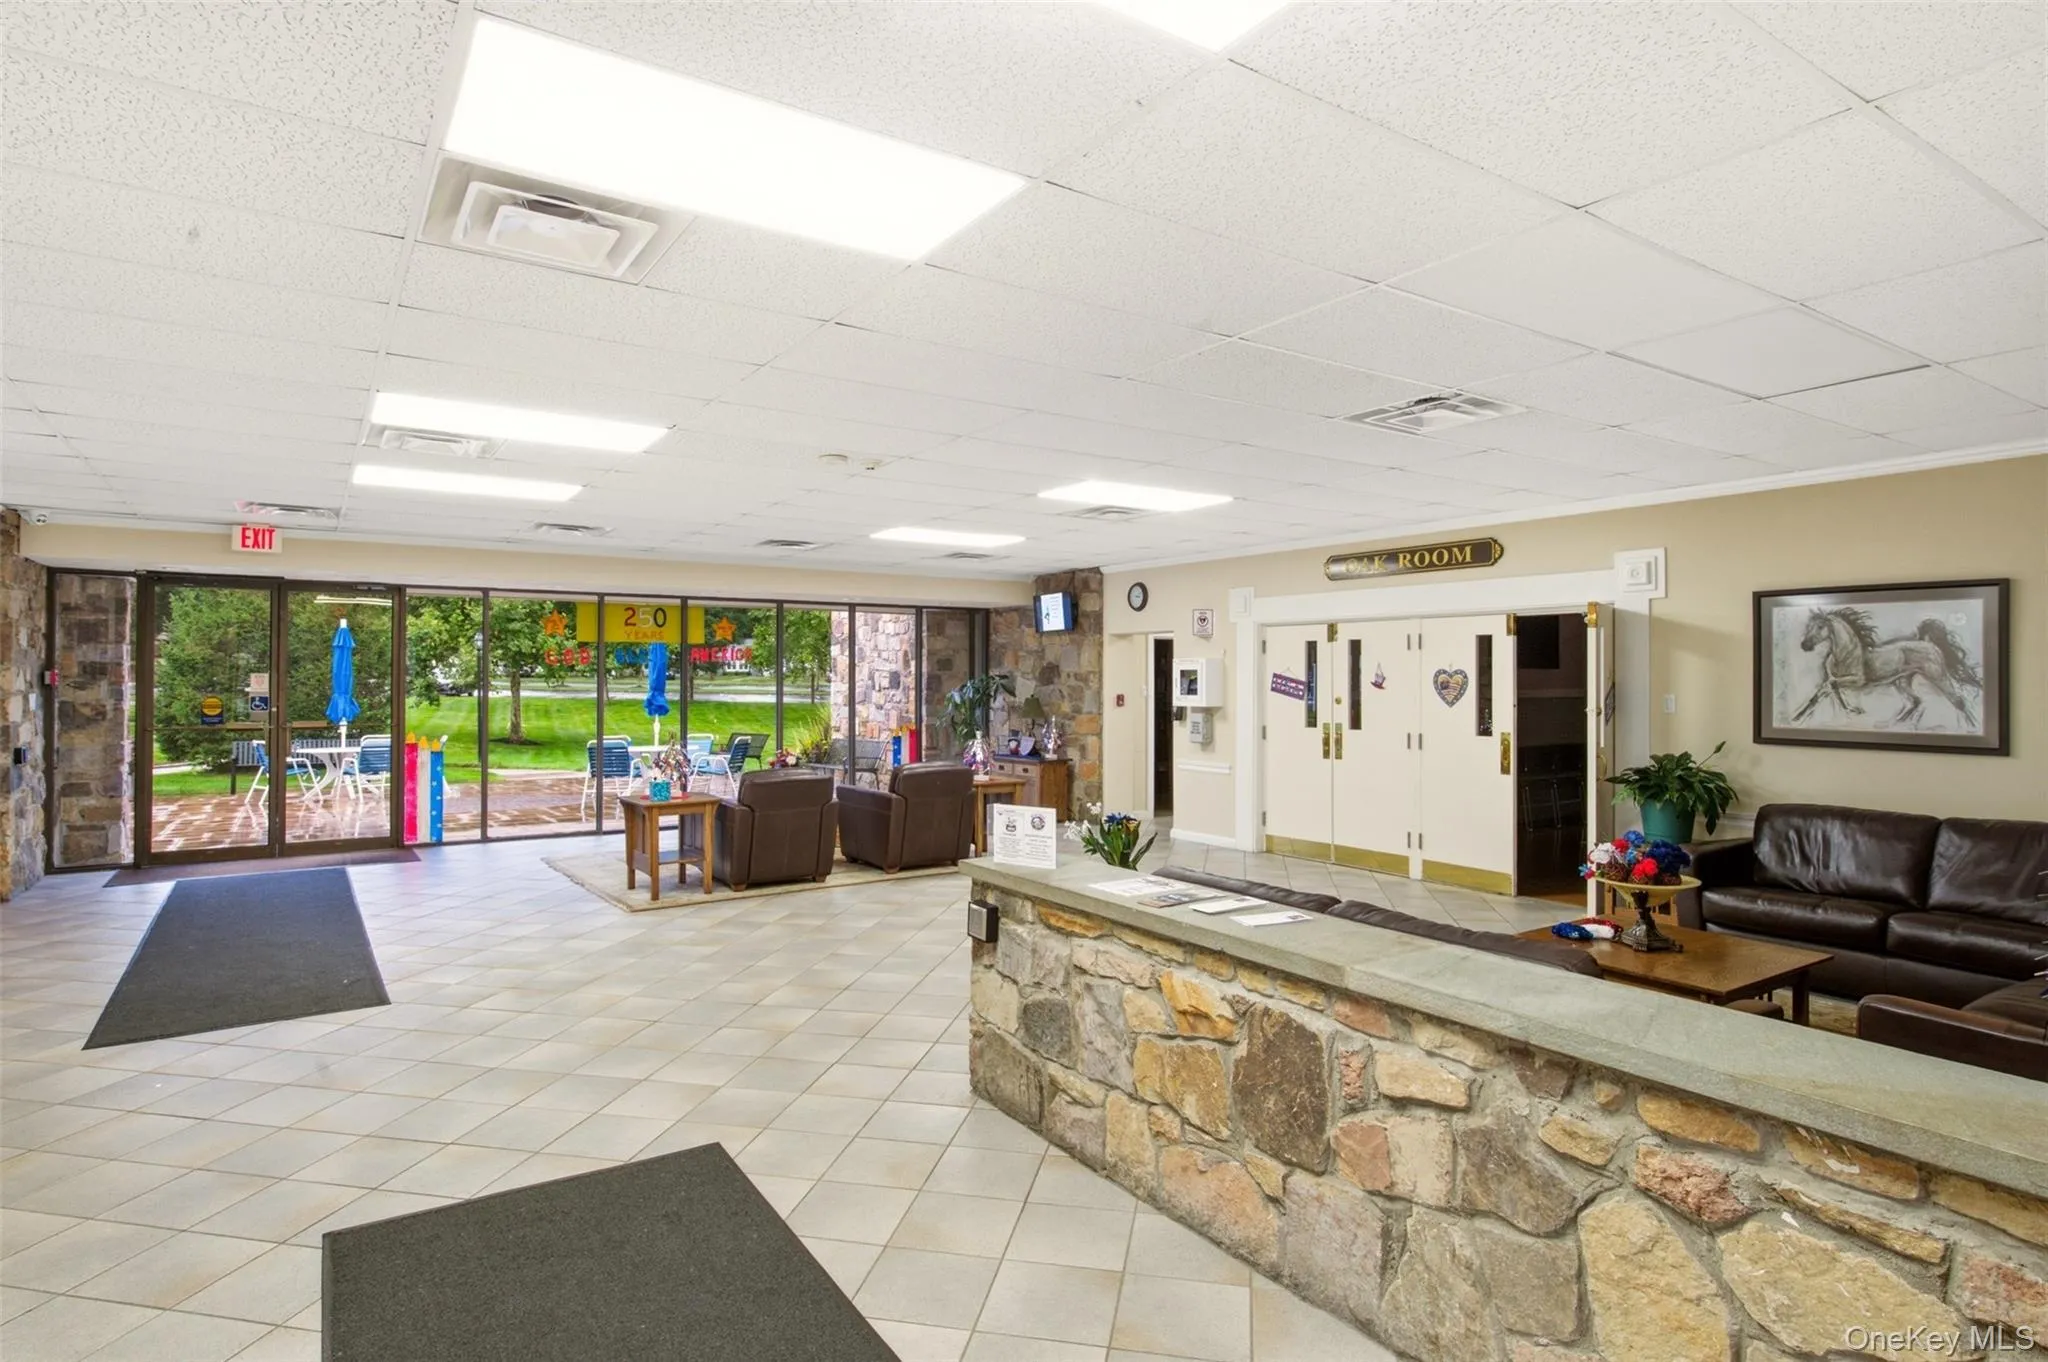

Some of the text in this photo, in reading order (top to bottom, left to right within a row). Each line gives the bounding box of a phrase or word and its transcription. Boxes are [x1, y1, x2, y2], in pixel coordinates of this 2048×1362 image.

[241, 527, 276, 550] EXIT
[1344, 545, 1473, 574] OAK ROOM
[624, 606, 667, 628] 250
[623, 630, 665, 640] YEARS
[690, 646, 753, 663] AMERICA
